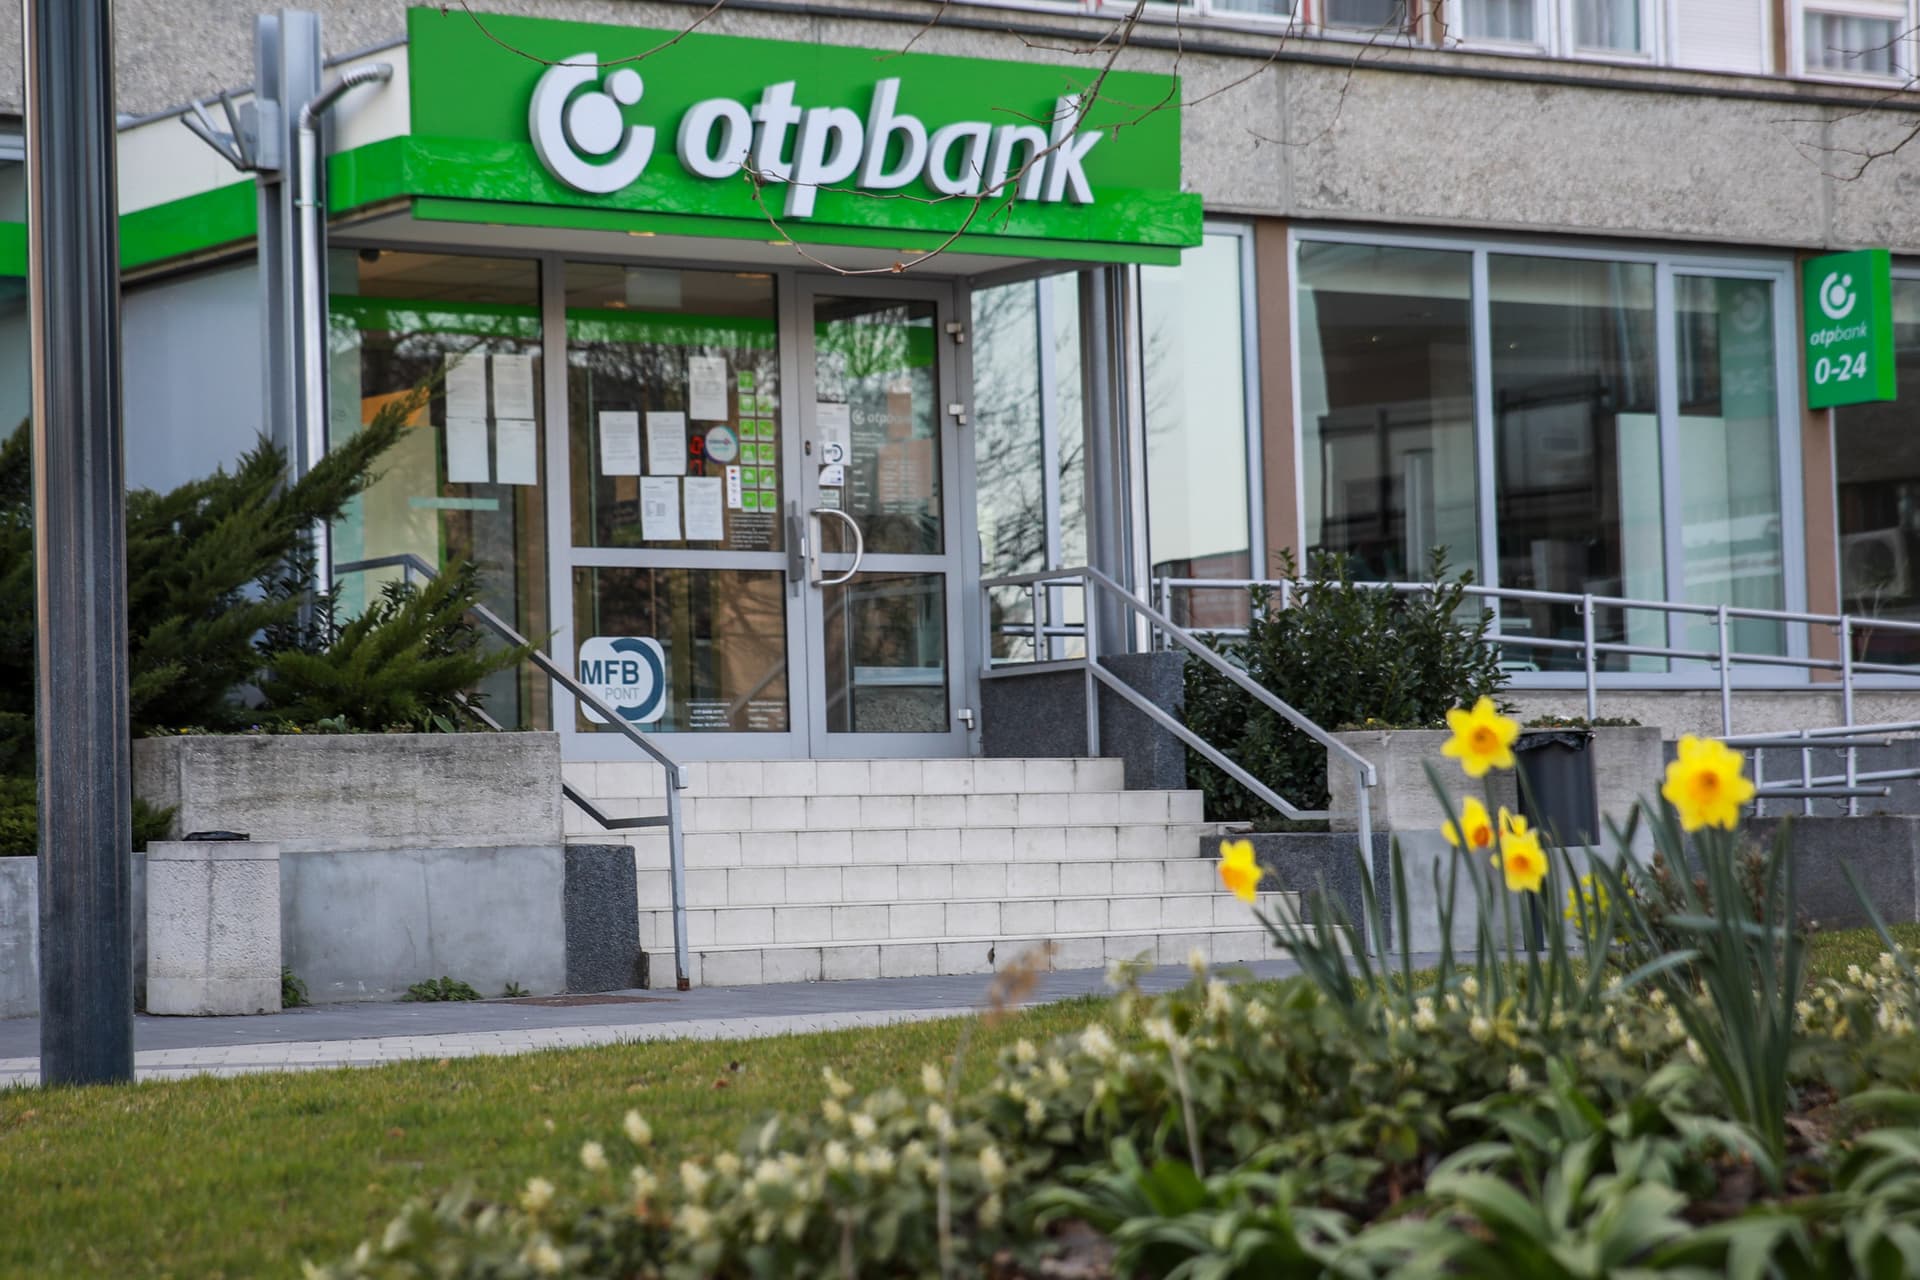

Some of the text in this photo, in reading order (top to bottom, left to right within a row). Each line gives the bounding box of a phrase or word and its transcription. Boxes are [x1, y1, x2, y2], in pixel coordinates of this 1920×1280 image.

[677, 77, 1103, 218] otpbank
[1810, 321, 1867, 349] otpbank
[1814, 351, 1867, 385] 0-24
[581, 660, 640, 685] MFB
[604, 687, 640, 700] PONT
